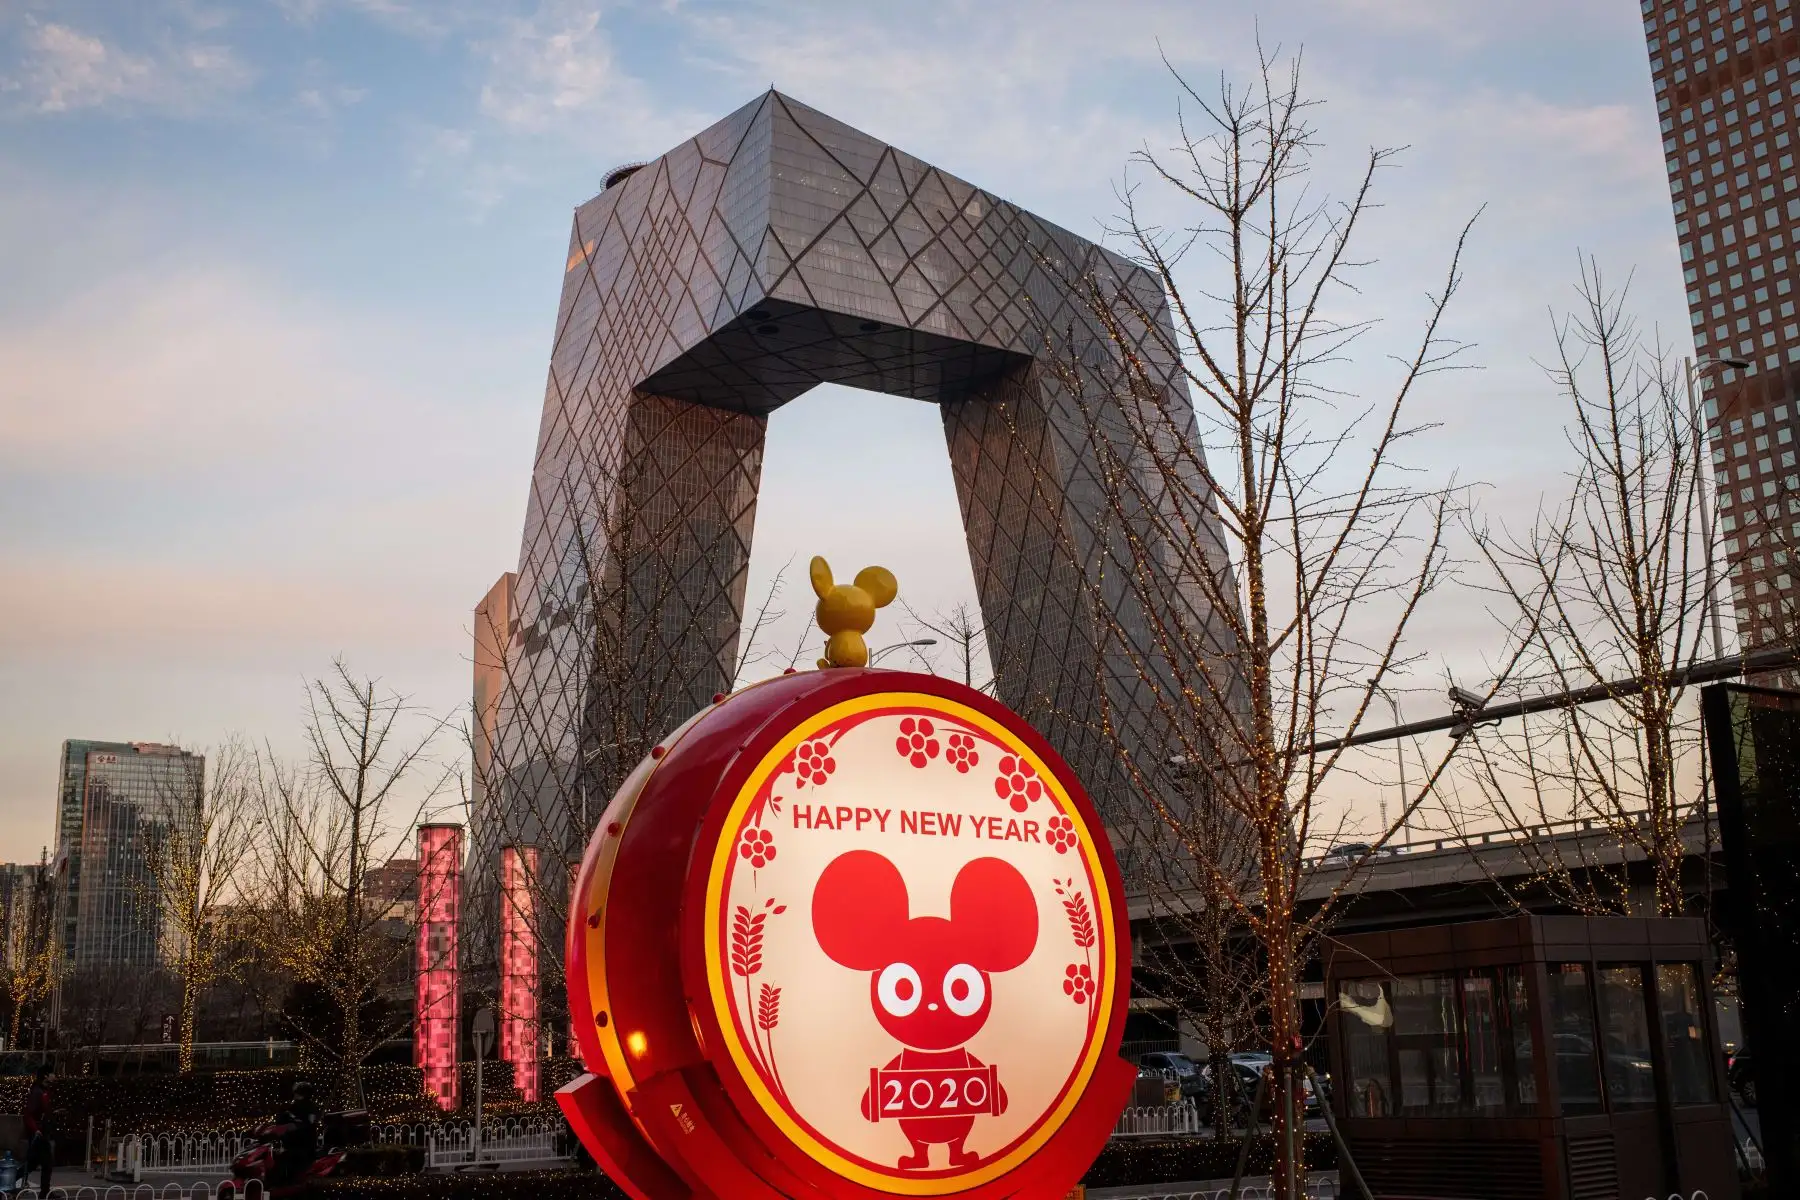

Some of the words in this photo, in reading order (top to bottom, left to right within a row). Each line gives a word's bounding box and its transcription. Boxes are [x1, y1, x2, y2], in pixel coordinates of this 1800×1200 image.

[793, 804, 891, 833] HAPPY
[900, 809, 962, 837] NEW
[969, 815, 1041, 844] YEAR
[883, 1076, 987, 1111] 2020
